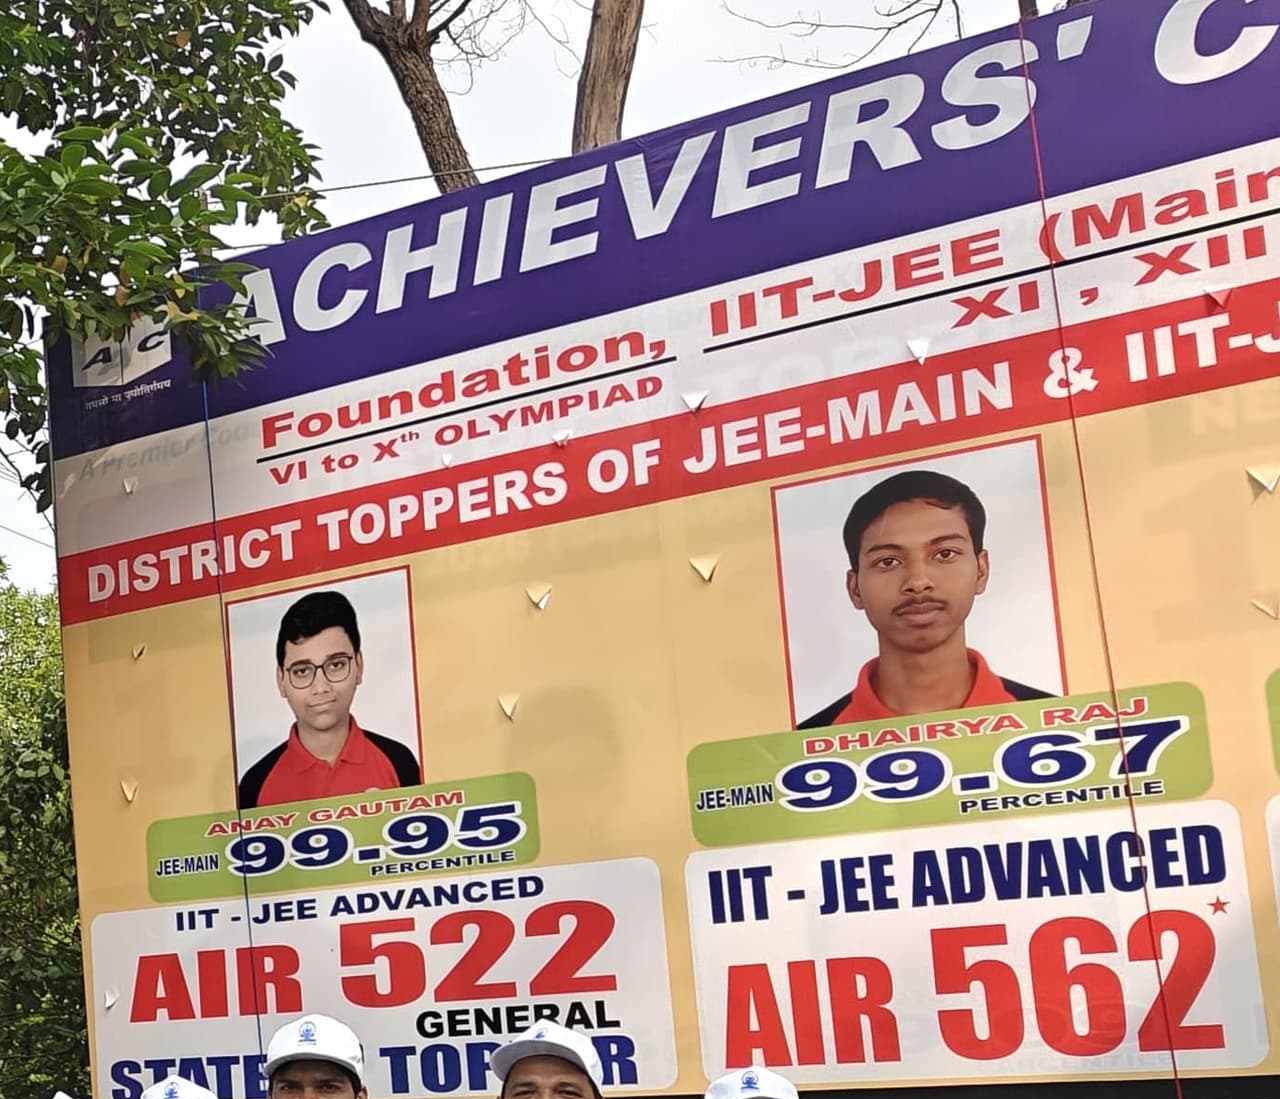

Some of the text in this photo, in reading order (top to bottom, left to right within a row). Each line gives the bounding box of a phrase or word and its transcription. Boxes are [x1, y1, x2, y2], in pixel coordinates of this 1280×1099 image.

[227, 16, 1093, 346] ACHIEVERS'
[952, 281, 1040, 329] XI
[1134, 225, 1267, 286] XII
[261, 328, 667, 450] Foundation,
[710, 228, 1004, 337] IIT-JEE
[88, 522, 302, 603] DISTRICT
[318, 461, 568, 551] TOPPERS
[587, 440, 661, 494] OF
[683, 361, 1014, 475] JEE-MAIN
[1042, 346, 1099, 401] &
[270, 461, 308, 486] VI
[321, 447, 360, 471] to
[434, 375, 664, 447] OLYMPIAD
[696, 716, 1185, 812] JEE-MAIN 99.67
[804, 697, 1149, 757] DHAIRYA RAJ
[156, 802, 525, 878] JEE-MAIN 99.95
[207, 790, 466, 837] ANAY GAUTAM
[959, 780, 1164, 814] PERCENTILE
[176, 908, 220, 932] IIT
[252, 897, 319, 925] JEE
[329, 875, 545, 917] ADVANCED
[370, 850, 517, 877] PERCENTILE
[708, 864, 773, 924] IIT
[819, 853, 899, 915] JEE
[911, 824, 1227, 908] ADVANCED
[129, 899, 618, 1024] AIR 522
[724, 908, 1226, 1070] AIR 562
[379, 1035, 639, 1095] TOPR
[416, 1000, 621, 1039] GENERAL
